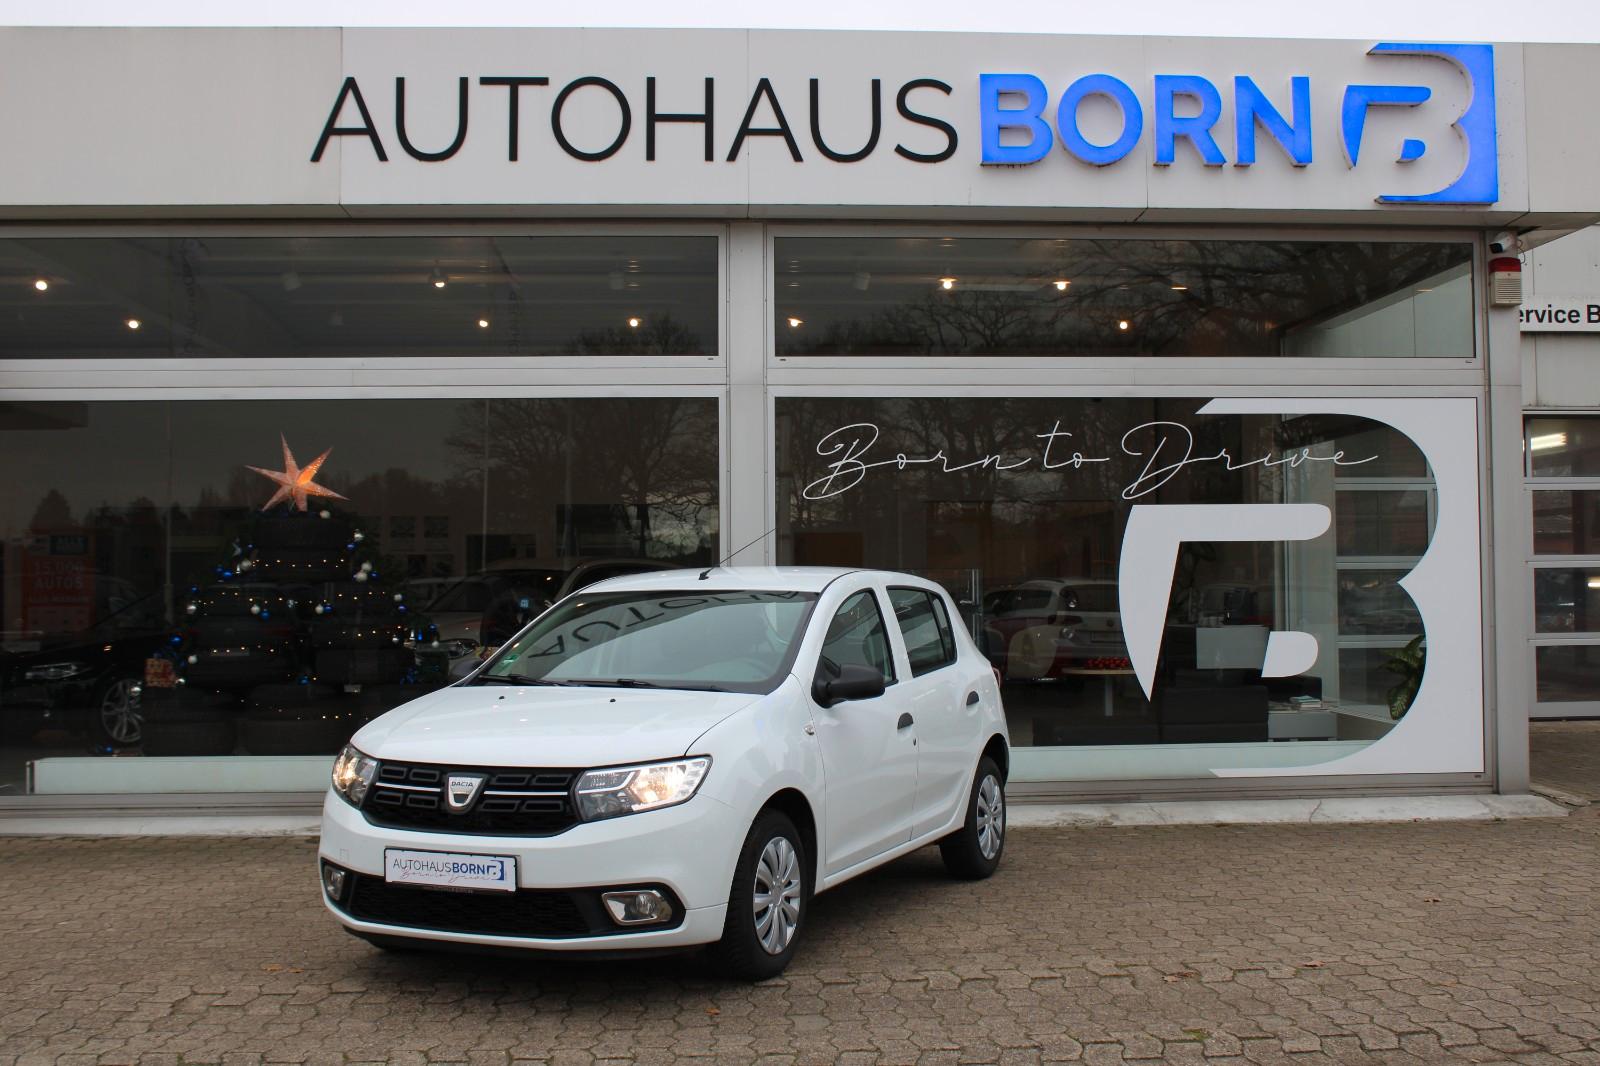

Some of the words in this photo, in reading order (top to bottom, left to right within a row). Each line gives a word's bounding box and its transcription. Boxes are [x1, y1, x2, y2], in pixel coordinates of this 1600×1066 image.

[803, 423, 1032, 500] Born
[1036, 421, 1109, 471] to
[1121, 421, 1379, 500] Drive
